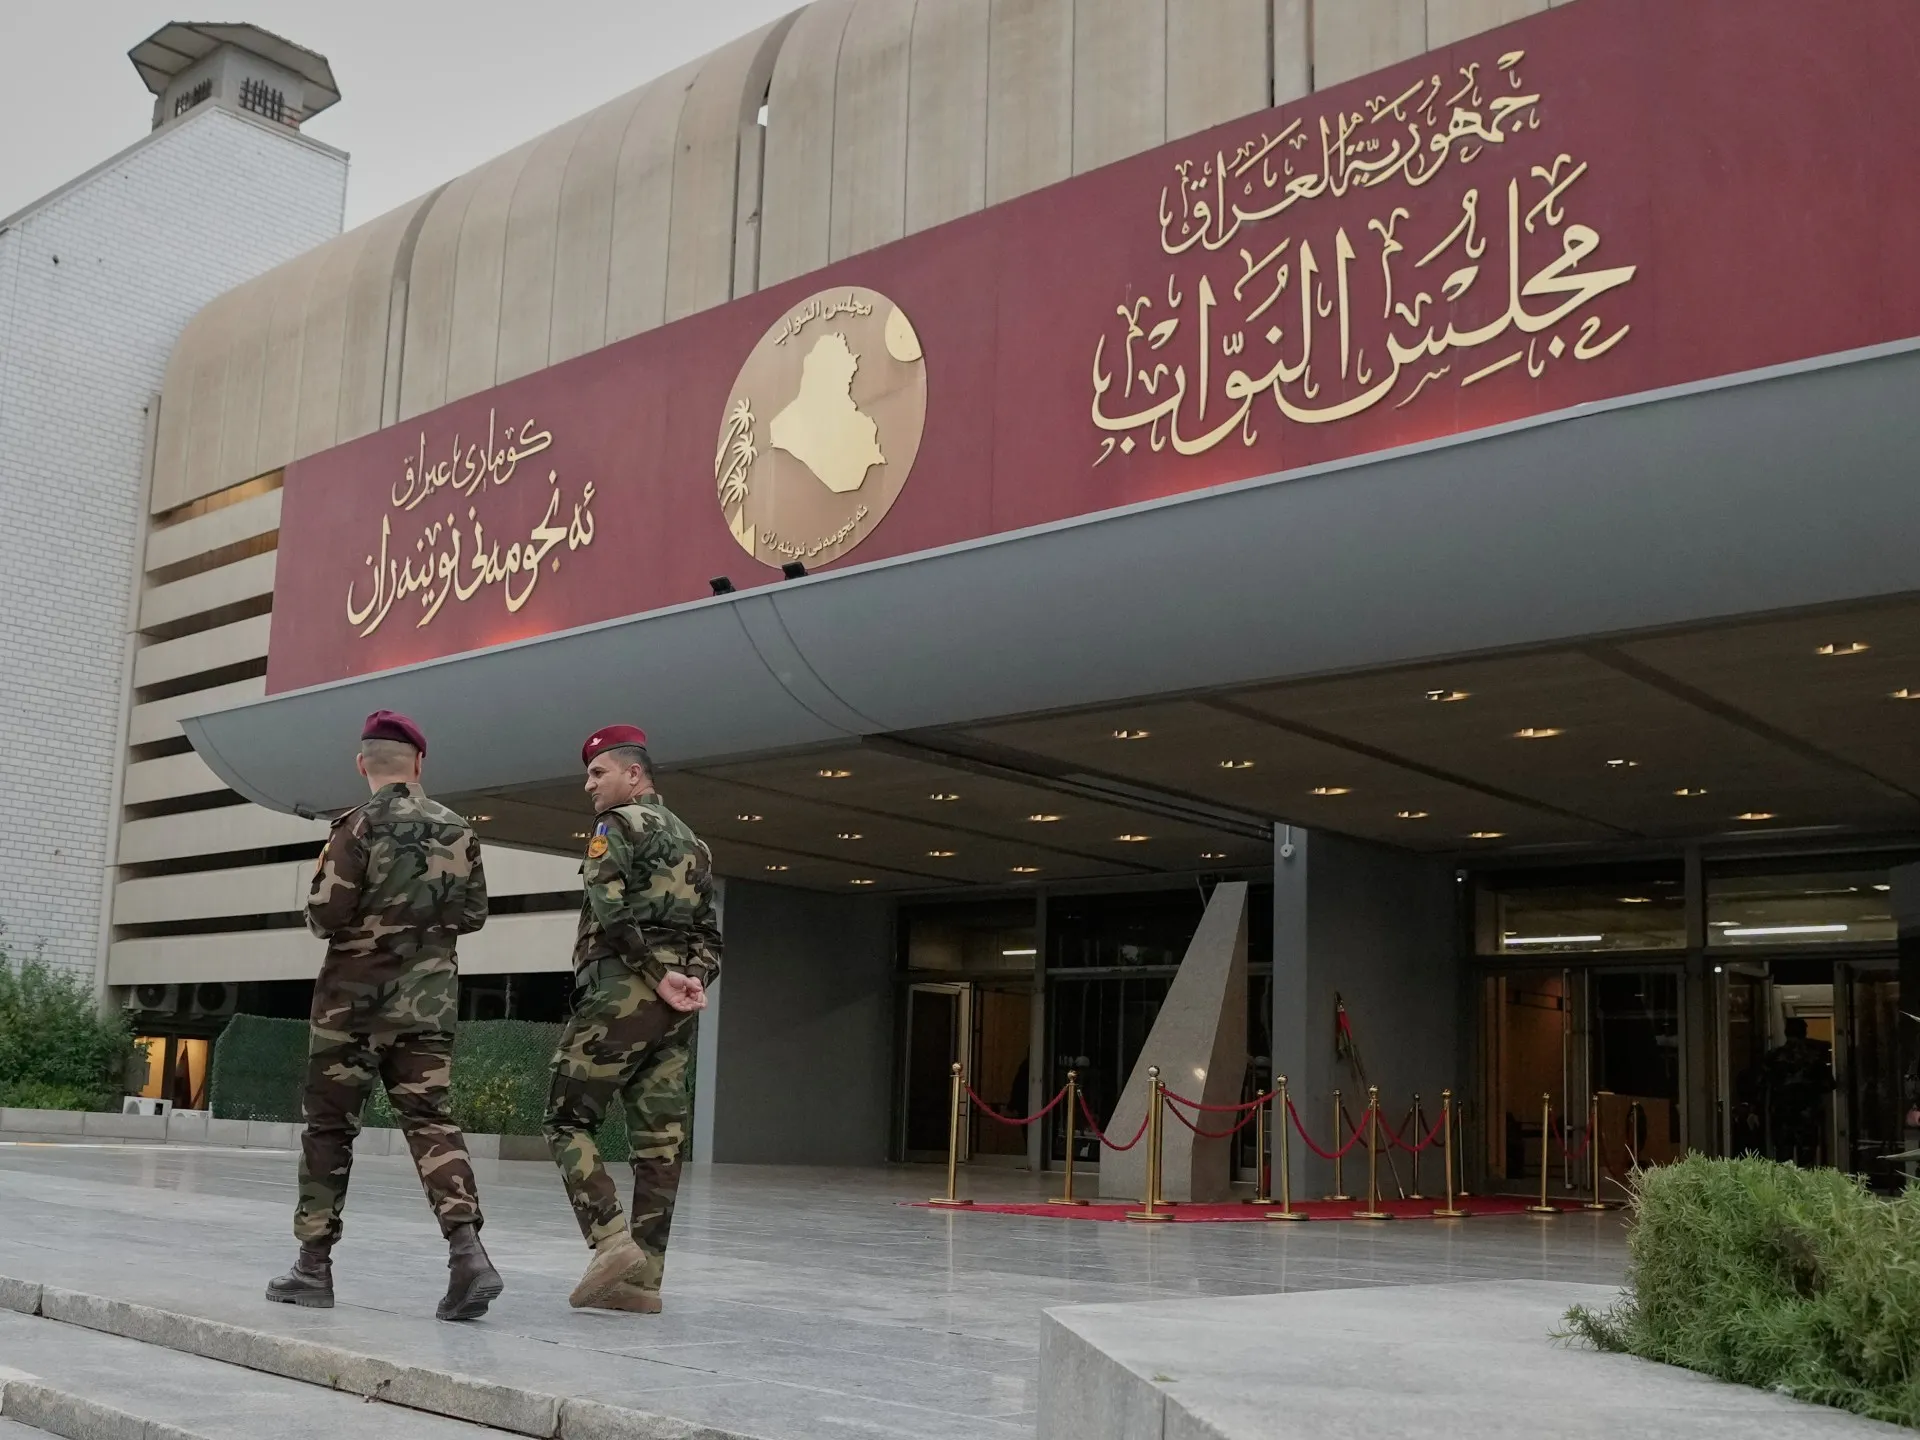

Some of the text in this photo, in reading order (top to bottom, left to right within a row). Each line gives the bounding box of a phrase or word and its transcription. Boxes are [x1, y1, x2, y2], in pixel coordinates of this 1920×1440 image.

[1159, 112, 1352, 255] العراق
[774, 292, 873, 346] مجلس النواب
